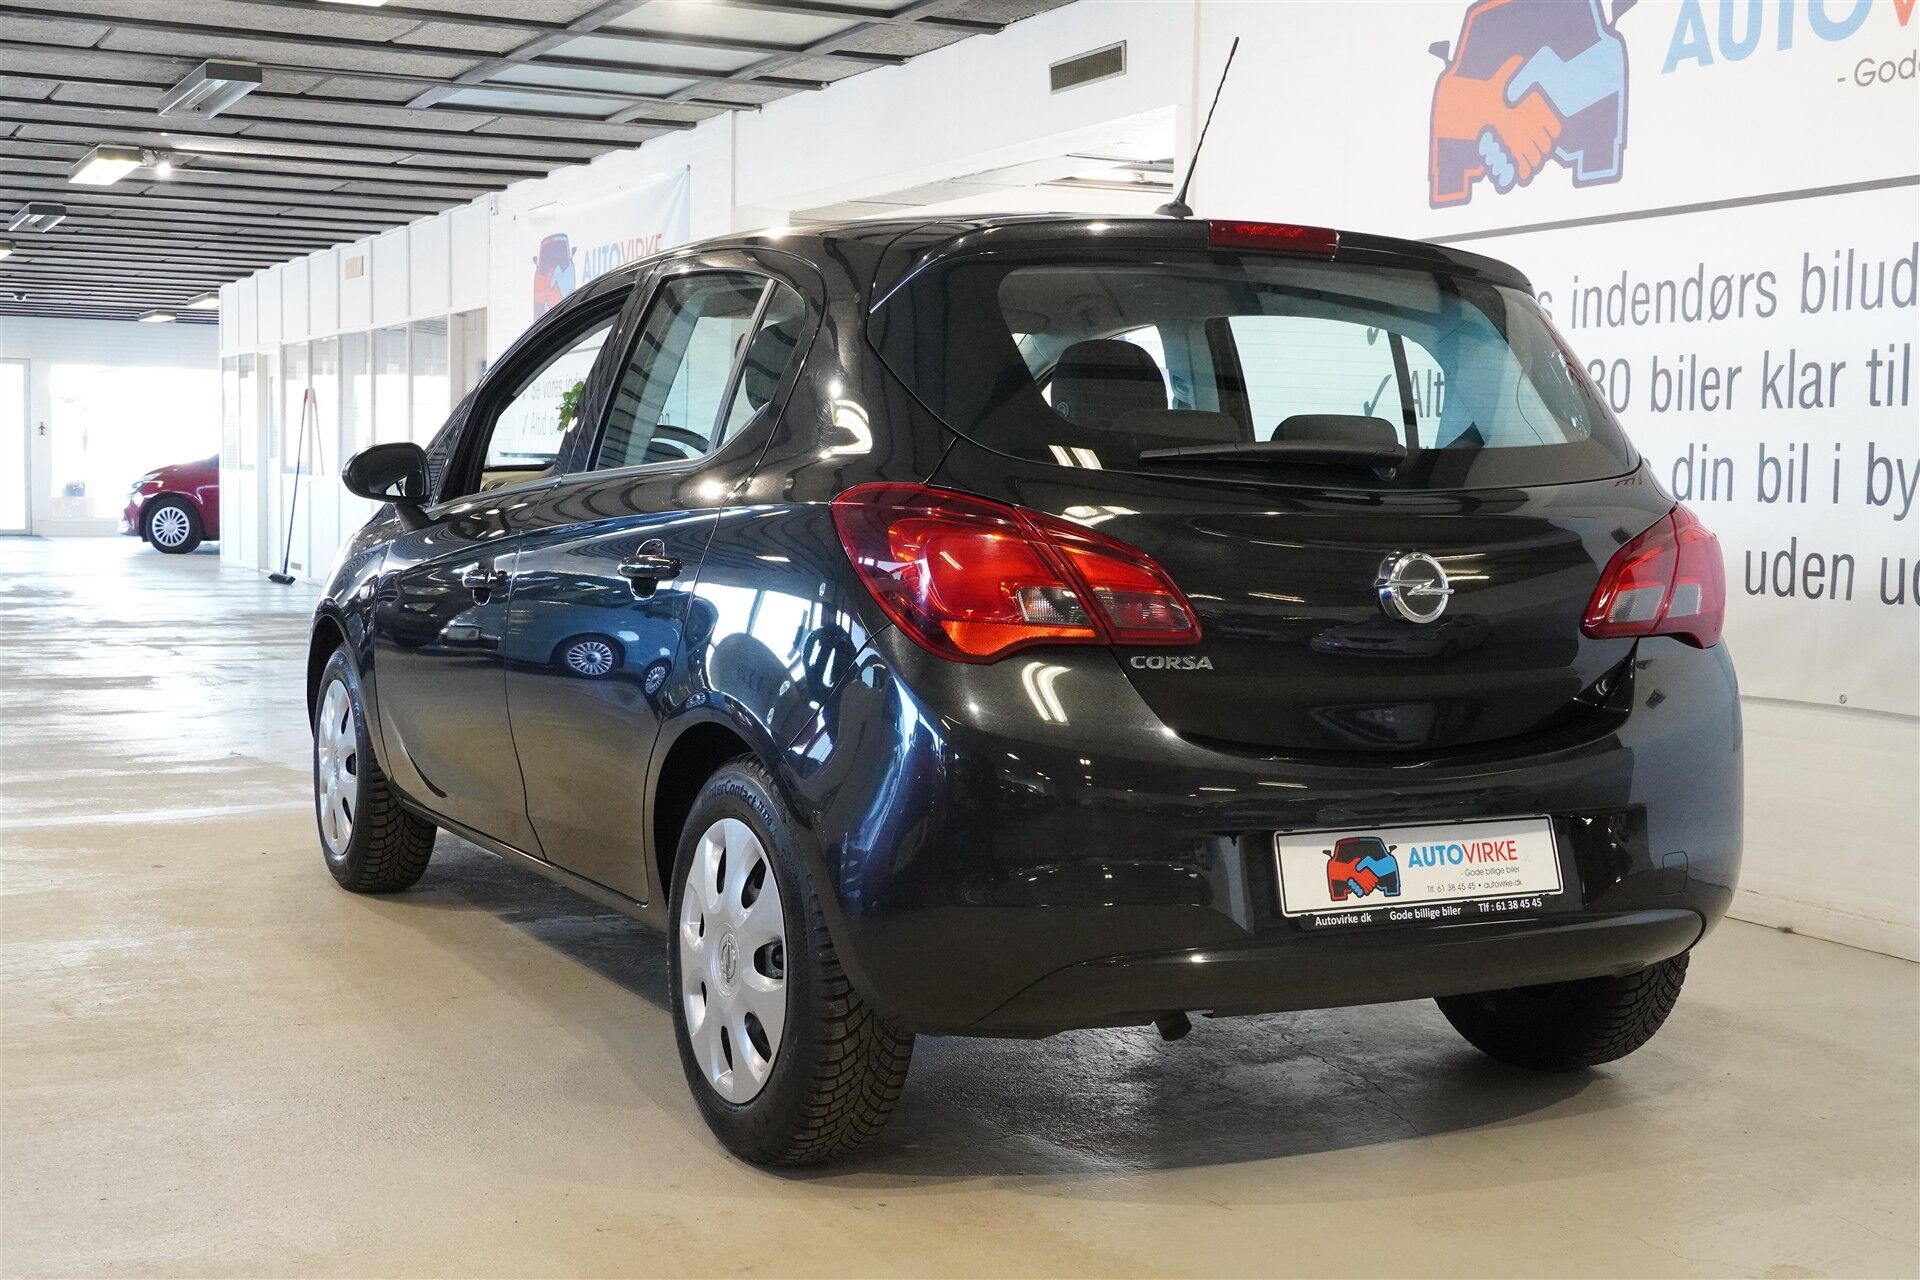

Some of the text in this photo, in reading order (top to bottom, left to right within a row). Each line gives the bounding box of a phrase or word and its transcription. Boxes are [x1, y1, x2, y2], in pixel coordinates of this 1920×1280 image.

[1854, 49, 1920, 87] God
[1571, 262, 1777, 329] indendørs
[1800, 241, 1919, 314] bilud
[1650, 354, 1742, 413] biler
[1761, 349, 1846, 410] klar
[1866, 343, 1910, 407] til
[1671, 443, 1734, 502] din
[1757, 442, 1808, 504] bil
[1832, 443, 1841, 504] i
[1745, 537, 1856, 601] uden
[1130, 655, 1214, 670] CORSA
[1408, 840, 1518, 868] AUTOVIRKE
[1457, 883, 1466, 891] 45
[1467, 882, 1476, 890] 45
[1389, 910, 1412, 921] Gode
[1414, 908, 1441, 920] billige
[1442, 906, 1462, 917] biler
[1495, 901, 1506, 912] 61
[1507, 900, 1518, 910] 38
[1519, 899, 1531, 909] 45
[1531, 897, 1542, 908] 45
